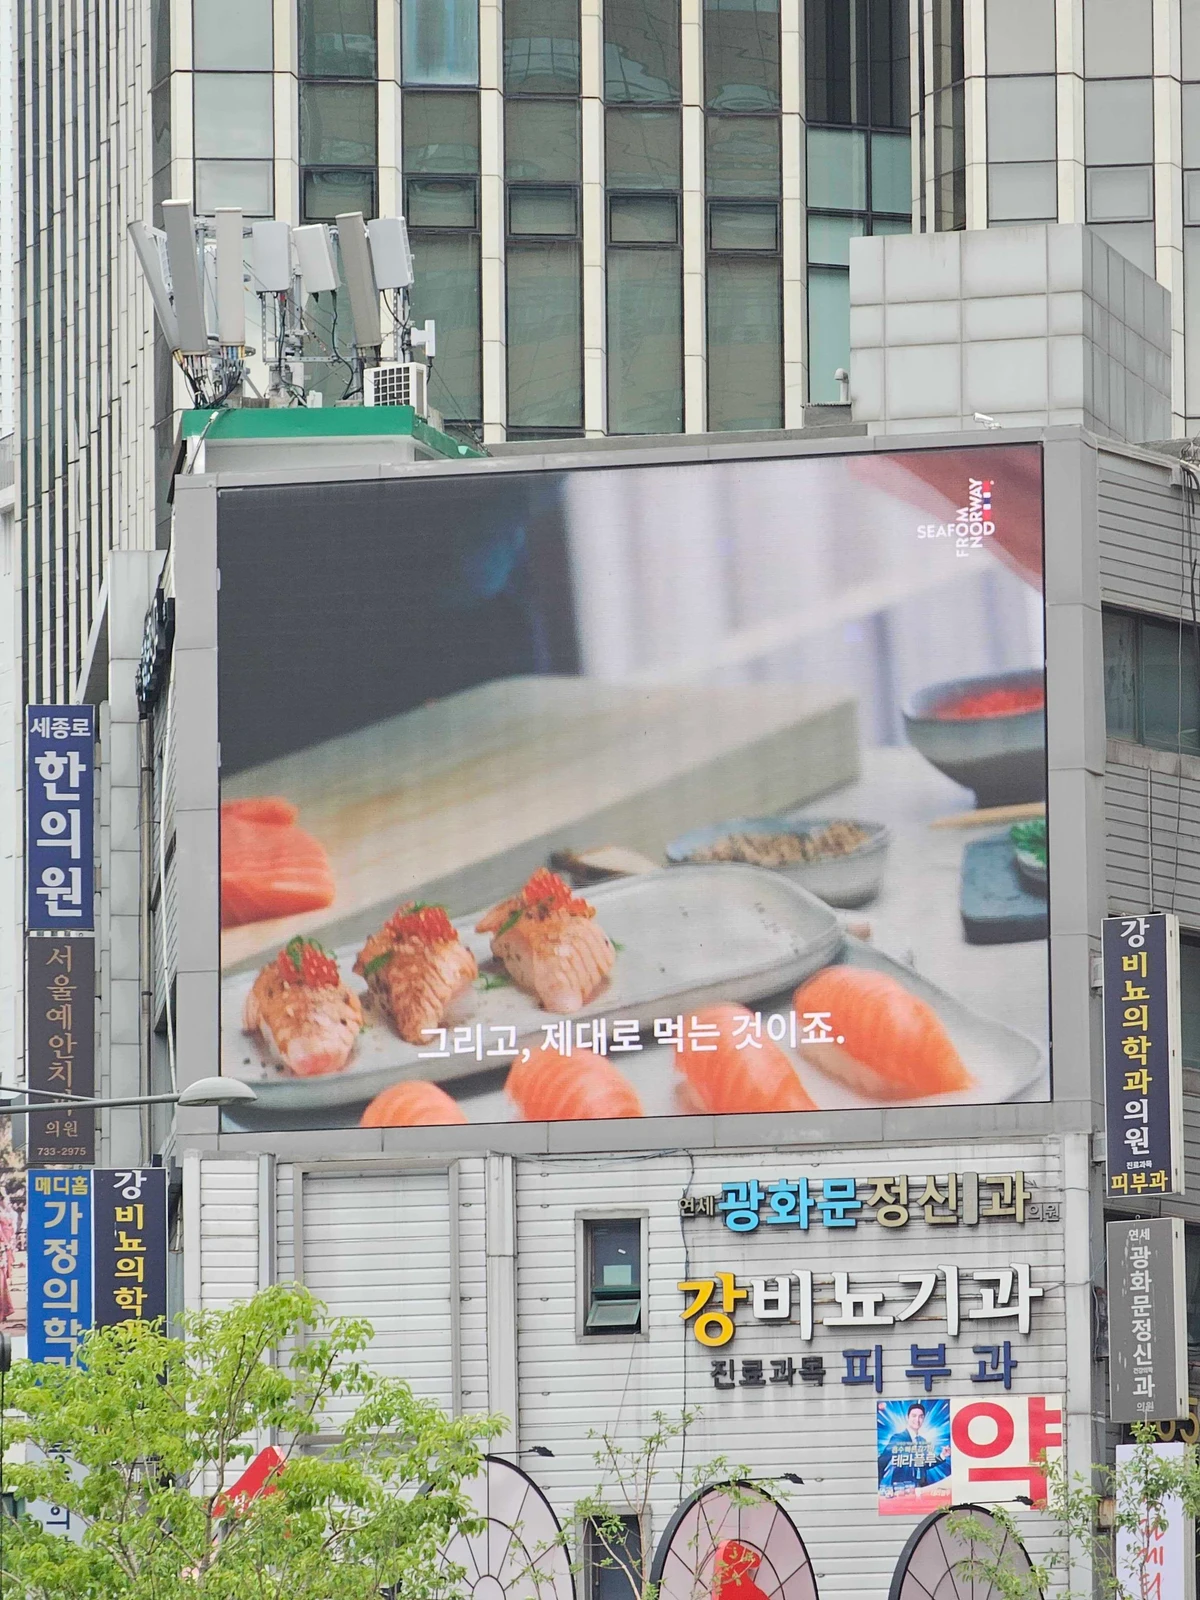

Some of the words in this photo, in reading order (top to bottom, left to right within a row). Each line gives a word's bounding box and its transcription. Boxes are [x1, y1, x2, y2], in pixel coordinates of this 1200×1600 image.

[969, 478, 983, 548] NORWAY
[917, 521, 995, 539] SEAFOOD
[956, 507, 969, 557] FROM
[30, 716, 91, 739] 세종로
[34, 750, 87, 917] 한의원
[45, 944, 78, 1117] 서울예안치
[417, 1023, 530, 1063] 그리고,
[540, 1018, 643, 1057] 제대로
[652, 1016, 721, 1052] 먹는
[730, 1011, 846, 1051] 것이죠.
[45, 1120, 79, 1138] 의원
[37, 1147, 87, 1156] 733-2975
[34, 1175, 89, 1196] 메디홈
[1111, 1170, 1168, 1194] 피부과
[678, 1196, 715, 1217] 연세
[1028, 1203, 1060, 1222] 의원
[1128, 1228, 1151, 1241] 연세
[676, 1262, 1044, 1347] 강비뇨기과
[710, 1356, 827, 1390] 진료과목
[841, 1340, 1018, 1393] 피부과
[1135, 1400, 1155, 1413] 의원
[891, 1454, 937, 1467] 테라플루
[952, 1396, 1062, 1510] 약
